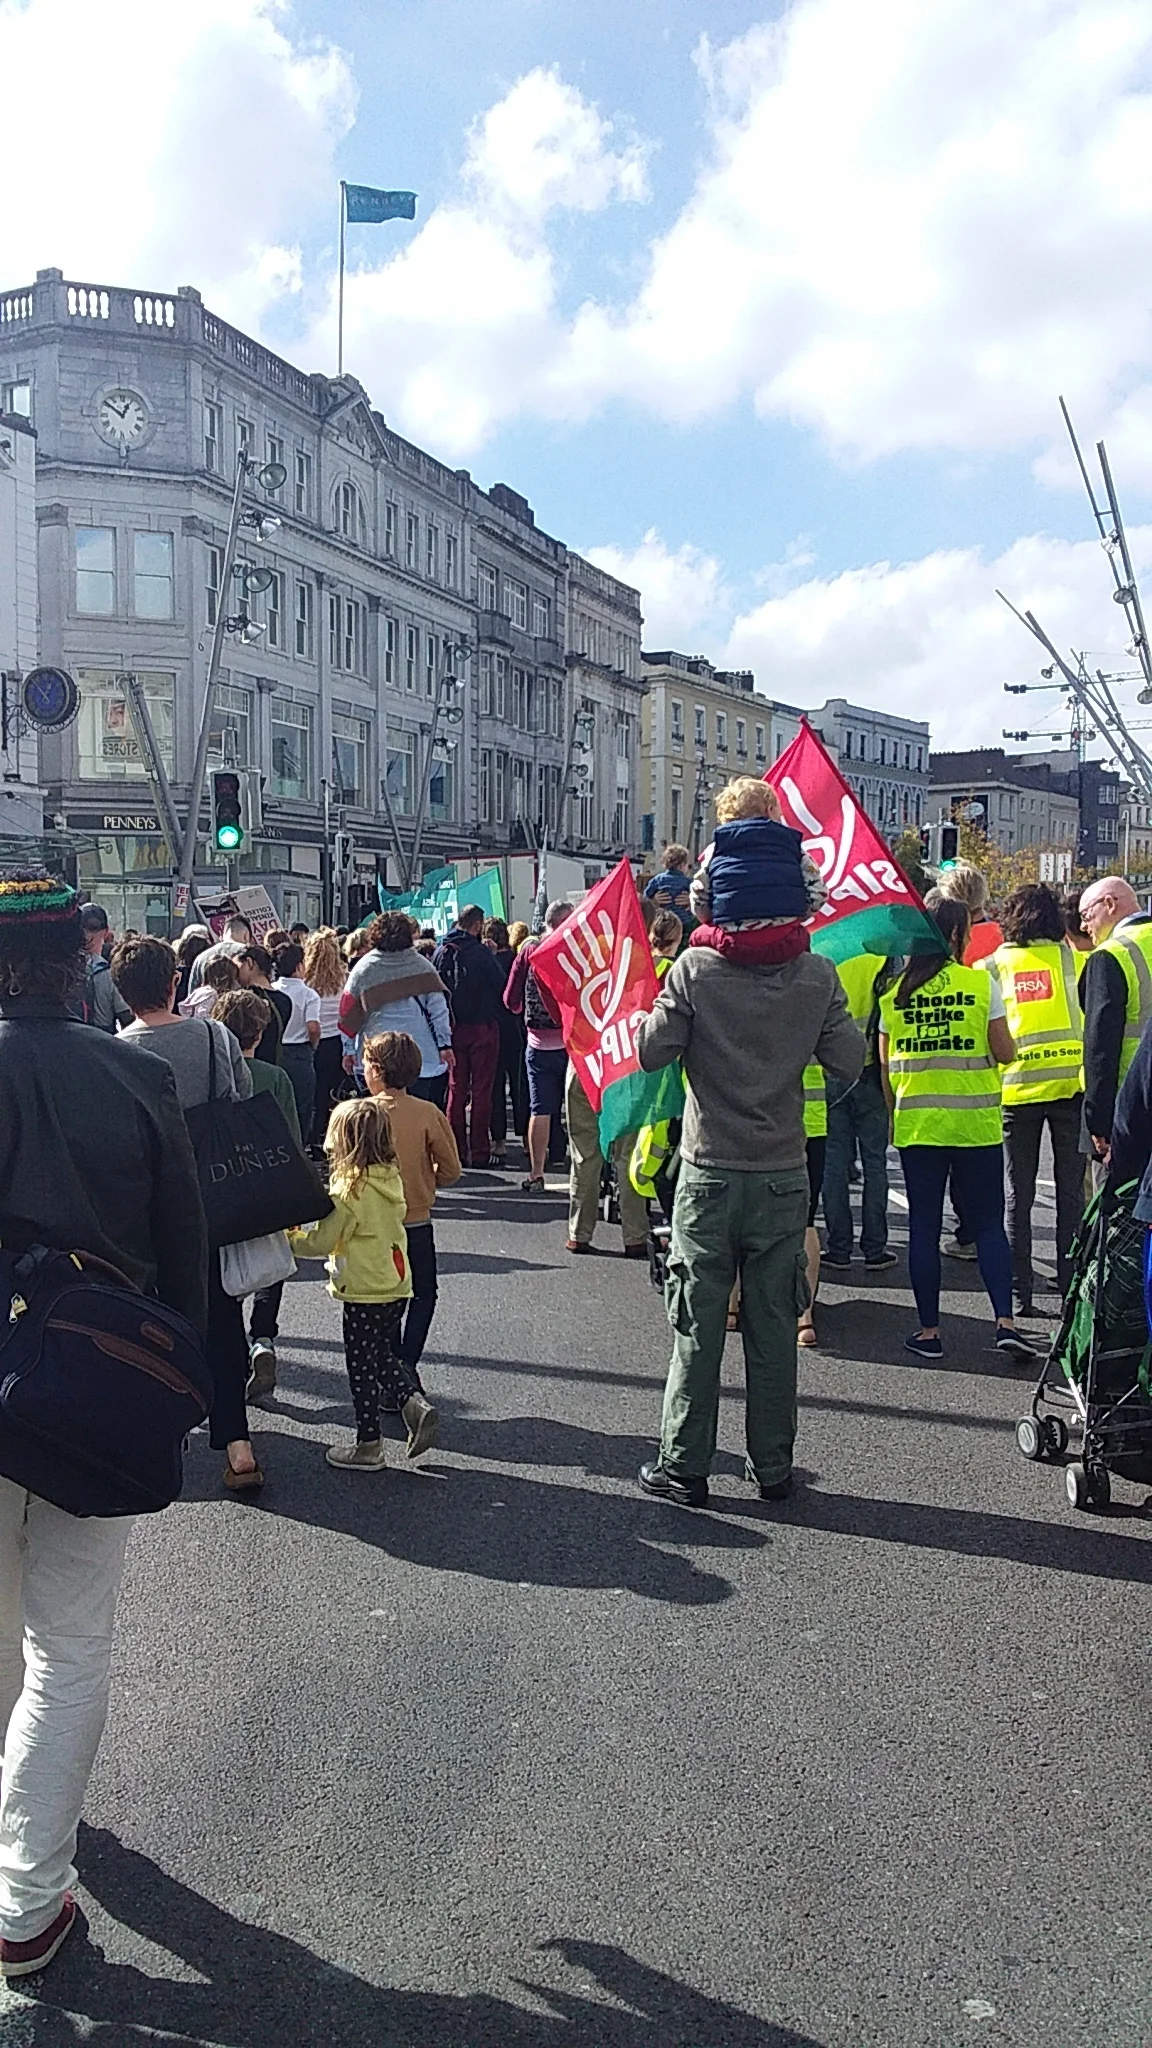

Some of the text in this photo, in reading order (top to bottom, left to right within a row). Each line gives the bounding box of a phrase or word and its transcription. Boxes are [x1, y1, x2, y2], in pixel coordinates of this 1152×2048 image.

[103, 816, 156, 830] PENNEYS
[1043, 855, 1051, 881] TAXI
[248, 912, 274, 921] KINSAL
[252, 919, 279, 934] DAY
[903, 1008, 965, 1025] Strike
[919, 1024, 948, 1039] for
[896, 1035, 976, 1053] Climate
[1017, 1051, 1041, 1062] Safe
[1043, 1049, 1058, 1058] Be
[210, 1146, 291, 1184] DUNES
